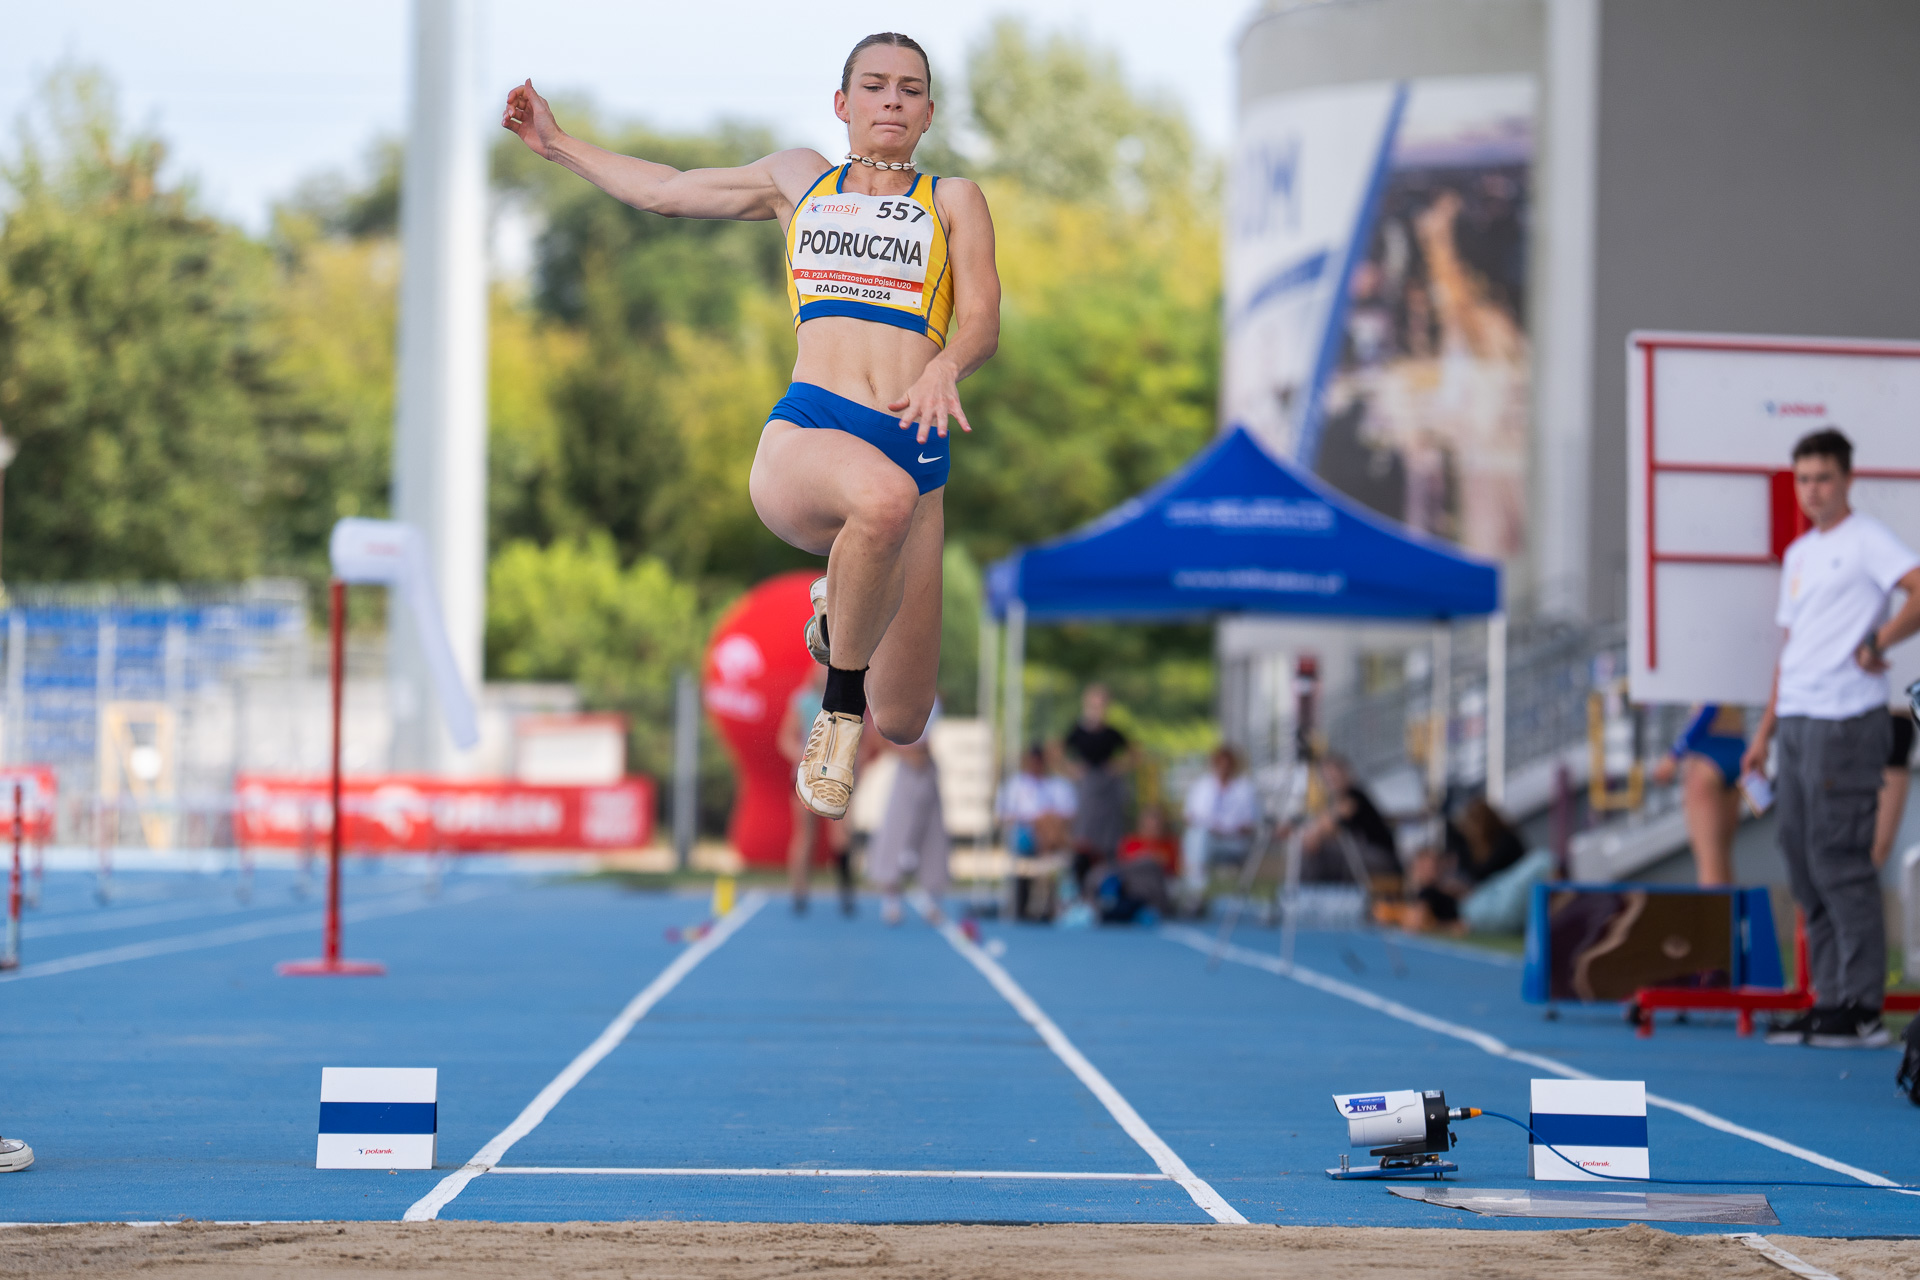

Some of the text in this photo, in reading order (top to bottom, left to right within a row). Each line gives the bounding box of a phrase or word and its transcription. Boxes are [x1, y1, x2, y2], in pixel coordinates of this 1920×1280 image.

[822, 203, 862, 215] mosir
[876, 201, 926, 223] 557
[799, 230, 922, 266] PODRUCZNA
[829, 272, 873, 284] Mistrzostwa
[874, 277, 896, 287] Polski
[897, 282, 912, 290] U20
[815, 284, 891, 301] RADOM 2024
[1356, 1104, 1378, 1112] LYNX
